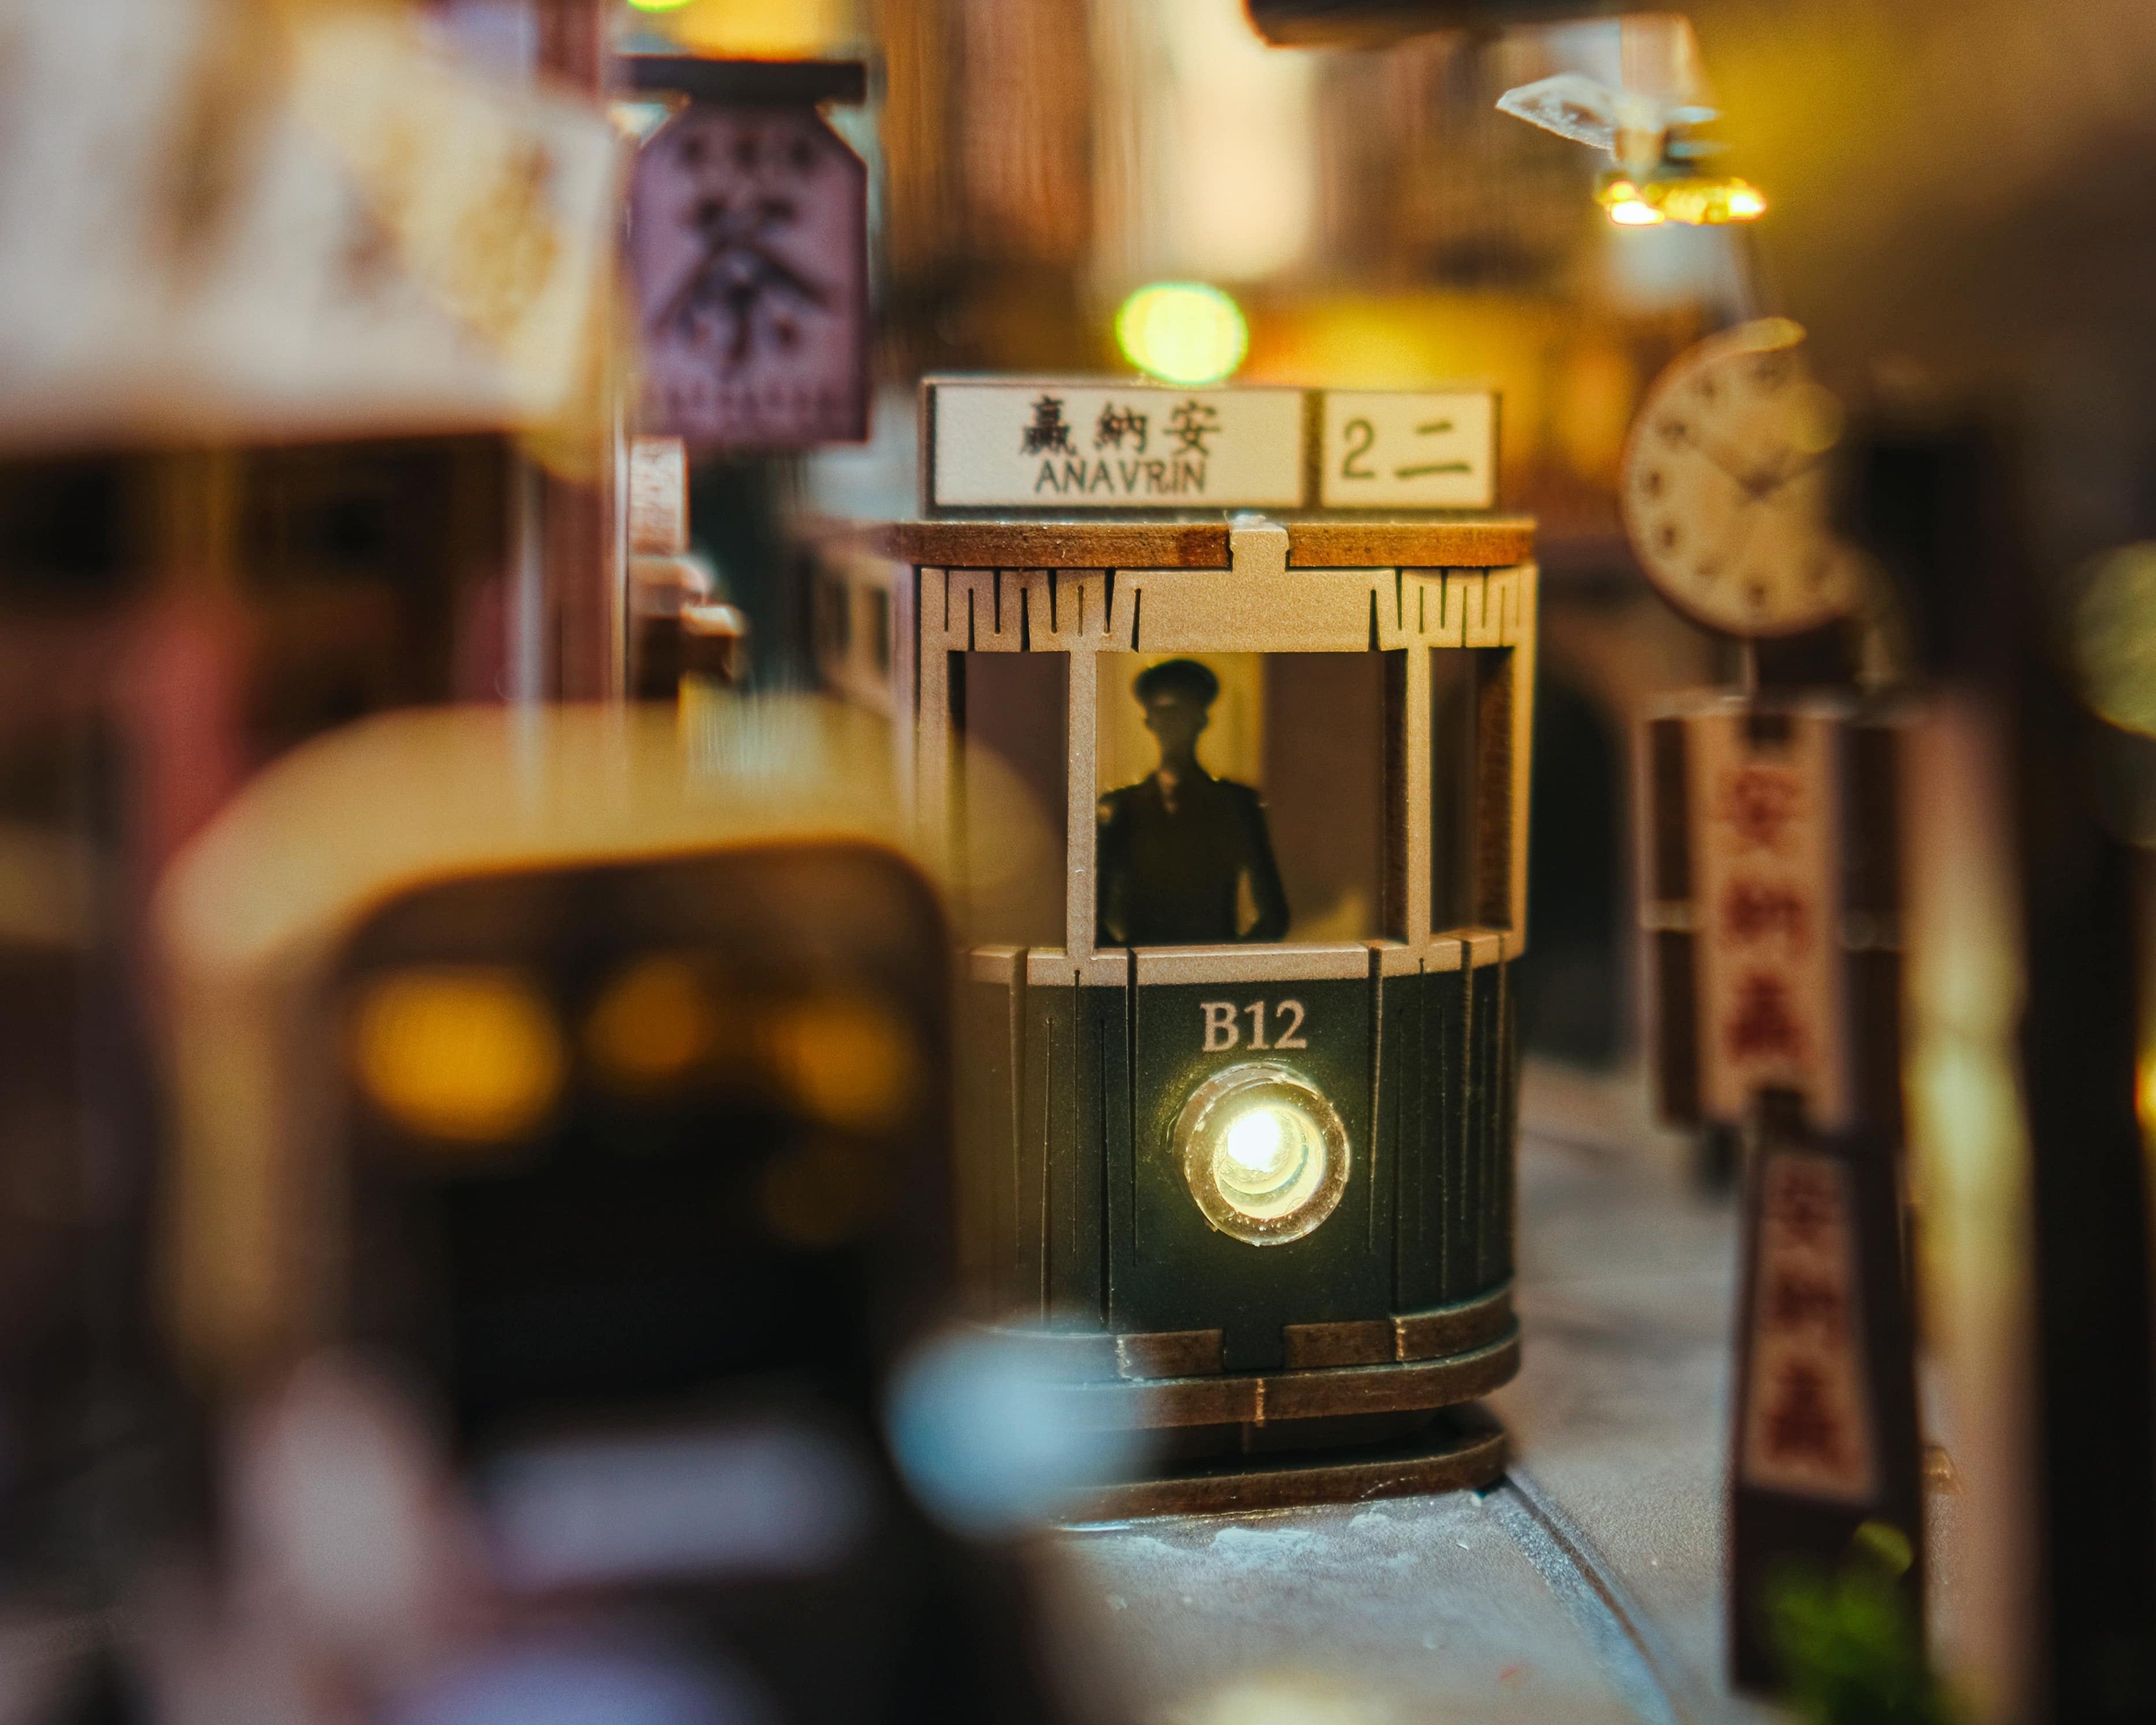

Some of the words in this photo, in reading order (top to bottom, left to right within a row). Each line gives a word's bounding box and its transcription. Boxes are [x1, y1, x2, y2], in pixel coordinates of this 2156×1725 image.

[1341, 418, 1376, 480] 2
[1394, 420, 1472, 480] 二
[1035, 459, 1206, 493] ANAVRIN
[1200, 999, 1308, 1052] B12
